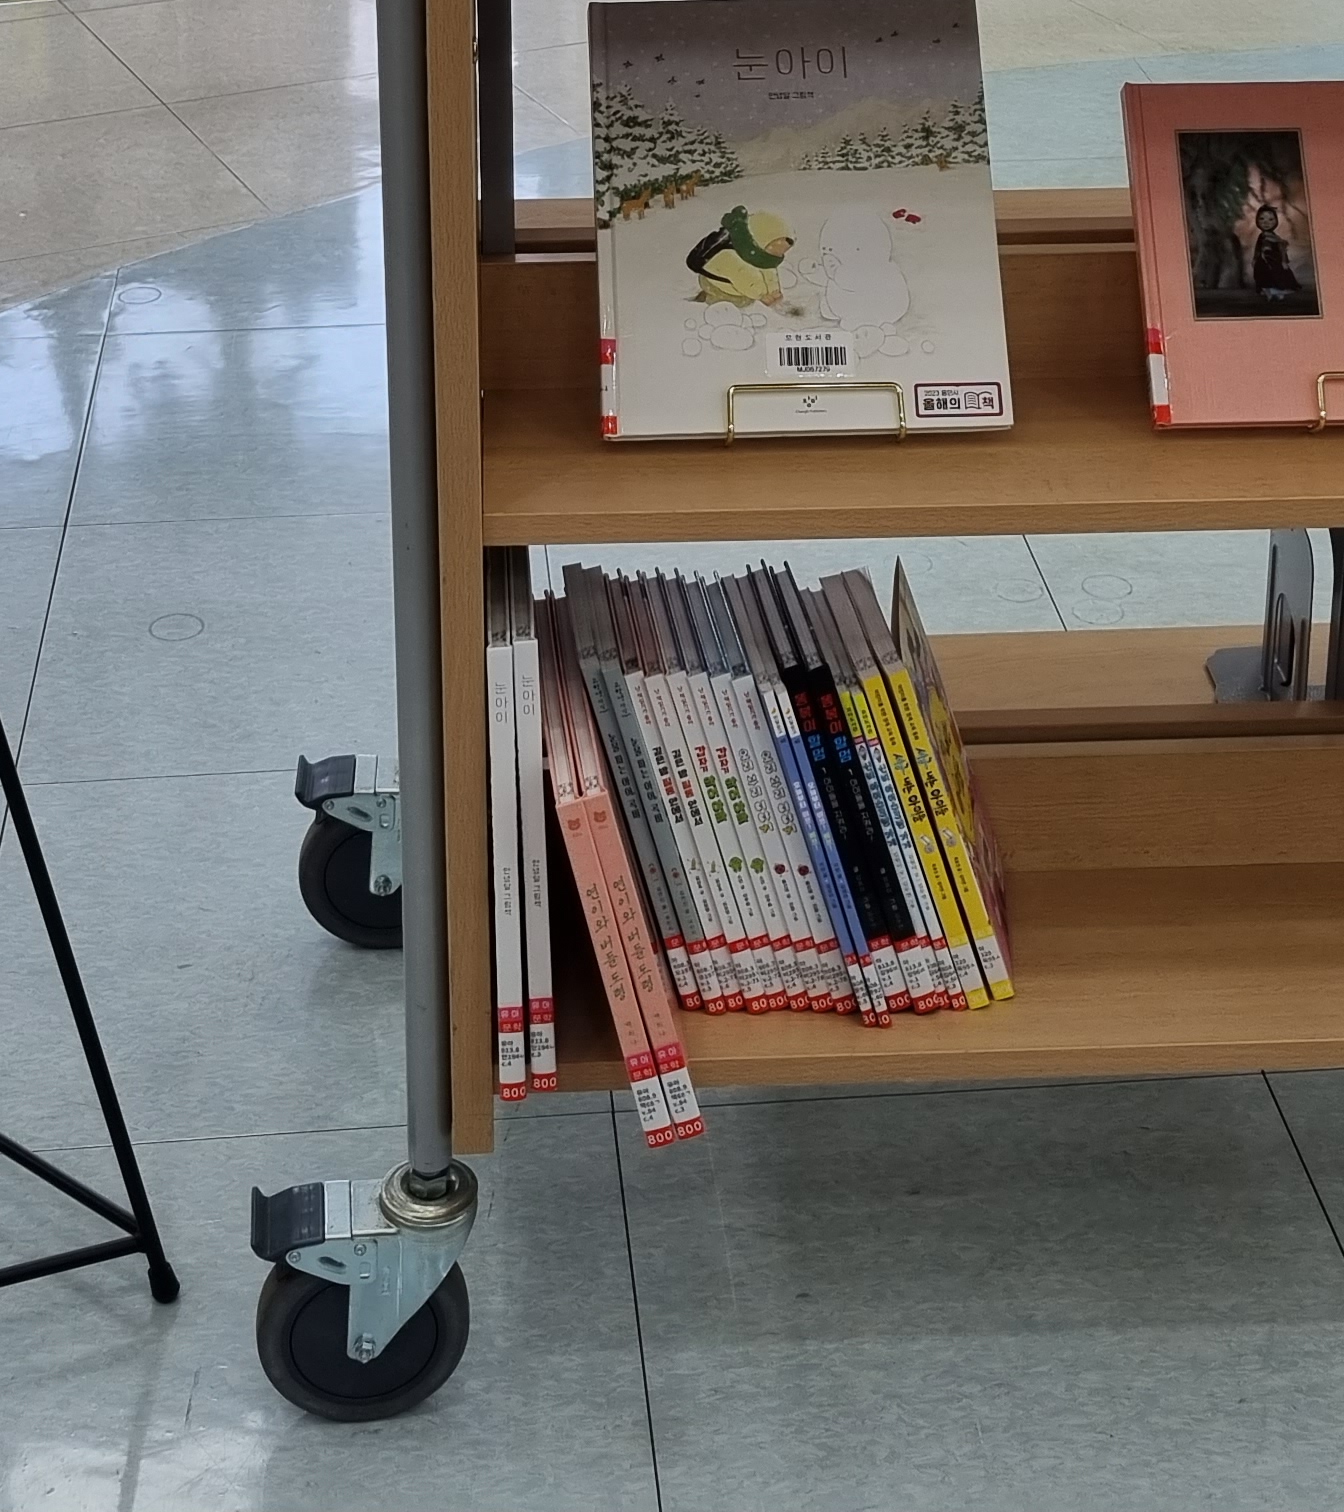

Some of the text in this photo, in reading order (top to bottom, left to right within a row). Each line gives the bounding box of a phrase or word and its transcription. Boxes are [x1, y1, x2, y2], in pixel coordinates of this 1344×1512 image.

[732, 45, 848, 82] 눈아이
[922, 396, 994, 411] 올해의 책
[613, 875, 653, 993] 연이와 버들 도령
[586, 883, 626, 1001] 연이와 버들 도령
[533, 1077, 557, 1089] 800
[502, 1087, 526, 1099] 800
[677, 1121, 702, 1136] 800
[647, 1130, 673, 1145] 800
